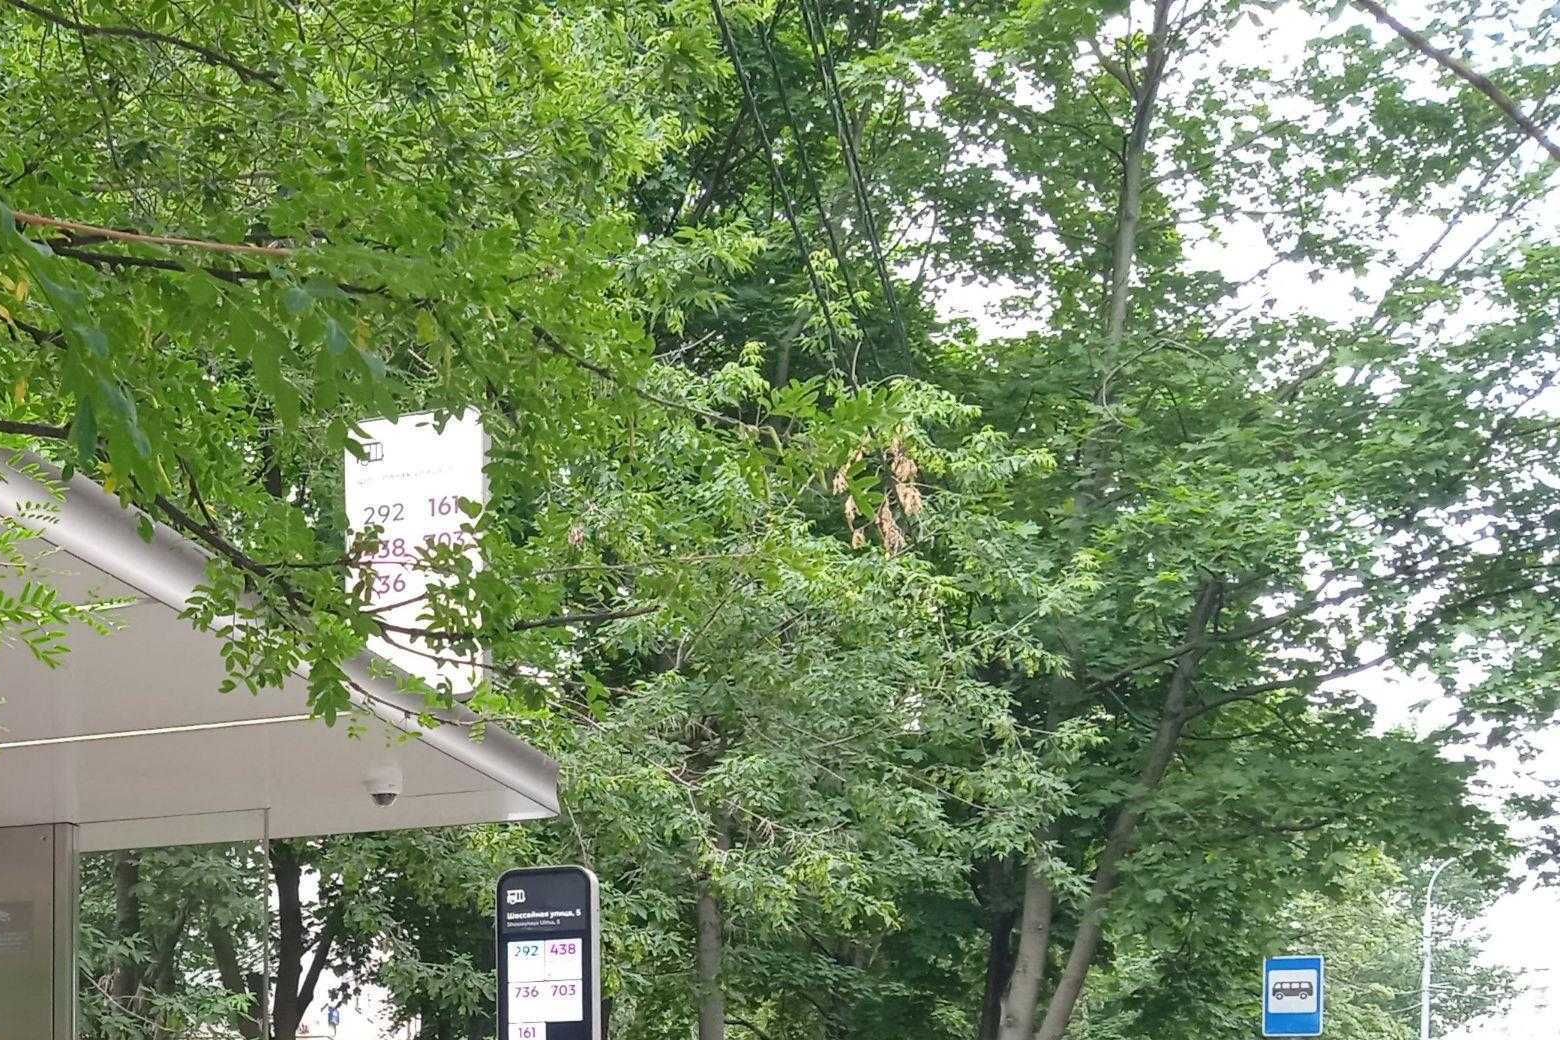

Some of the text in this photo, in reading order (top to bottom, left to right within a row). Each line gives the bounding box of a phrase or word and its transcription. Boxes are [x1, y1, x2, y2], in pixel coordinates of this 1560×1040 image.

[363, 496, 459, 525] 292 161
[363, 538, 406, 559] 38
[376, 573, 406, 594] 36
[514, 943, 577, 957] 292 438
[515, 984, 576, 998] 736 703
[518, 1027, 536, 1039] 161
